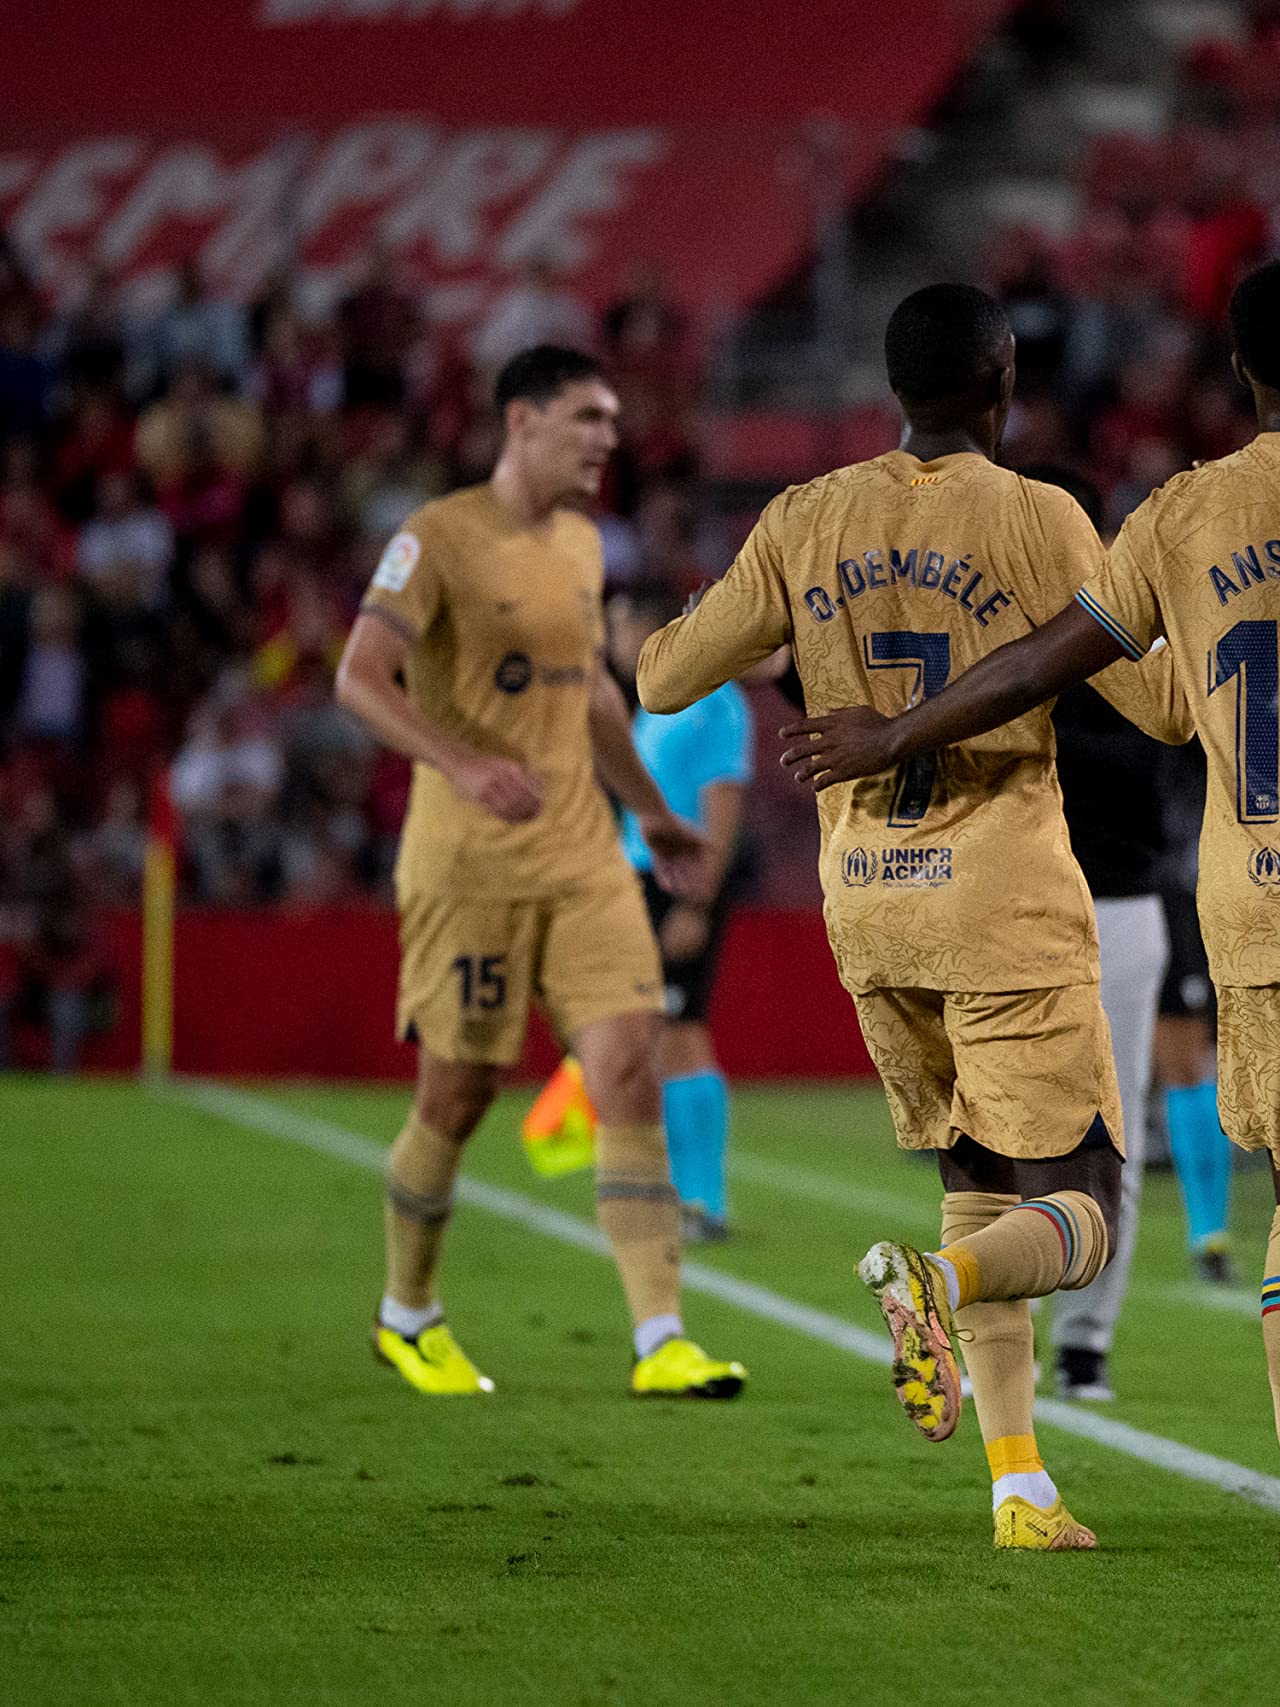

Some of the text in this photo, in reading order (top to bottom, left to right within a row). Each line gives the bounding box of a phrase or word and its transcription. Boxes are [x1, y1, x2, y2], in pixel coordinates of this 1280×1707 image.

[0, 113, 666, 276] EMPRE
[863, 631, 950, 828] 7
[882, 848, 952, 863] UNHCR
[882, 865, 952, 880] ACNUR
[452, 954, 504, 1008] 15
